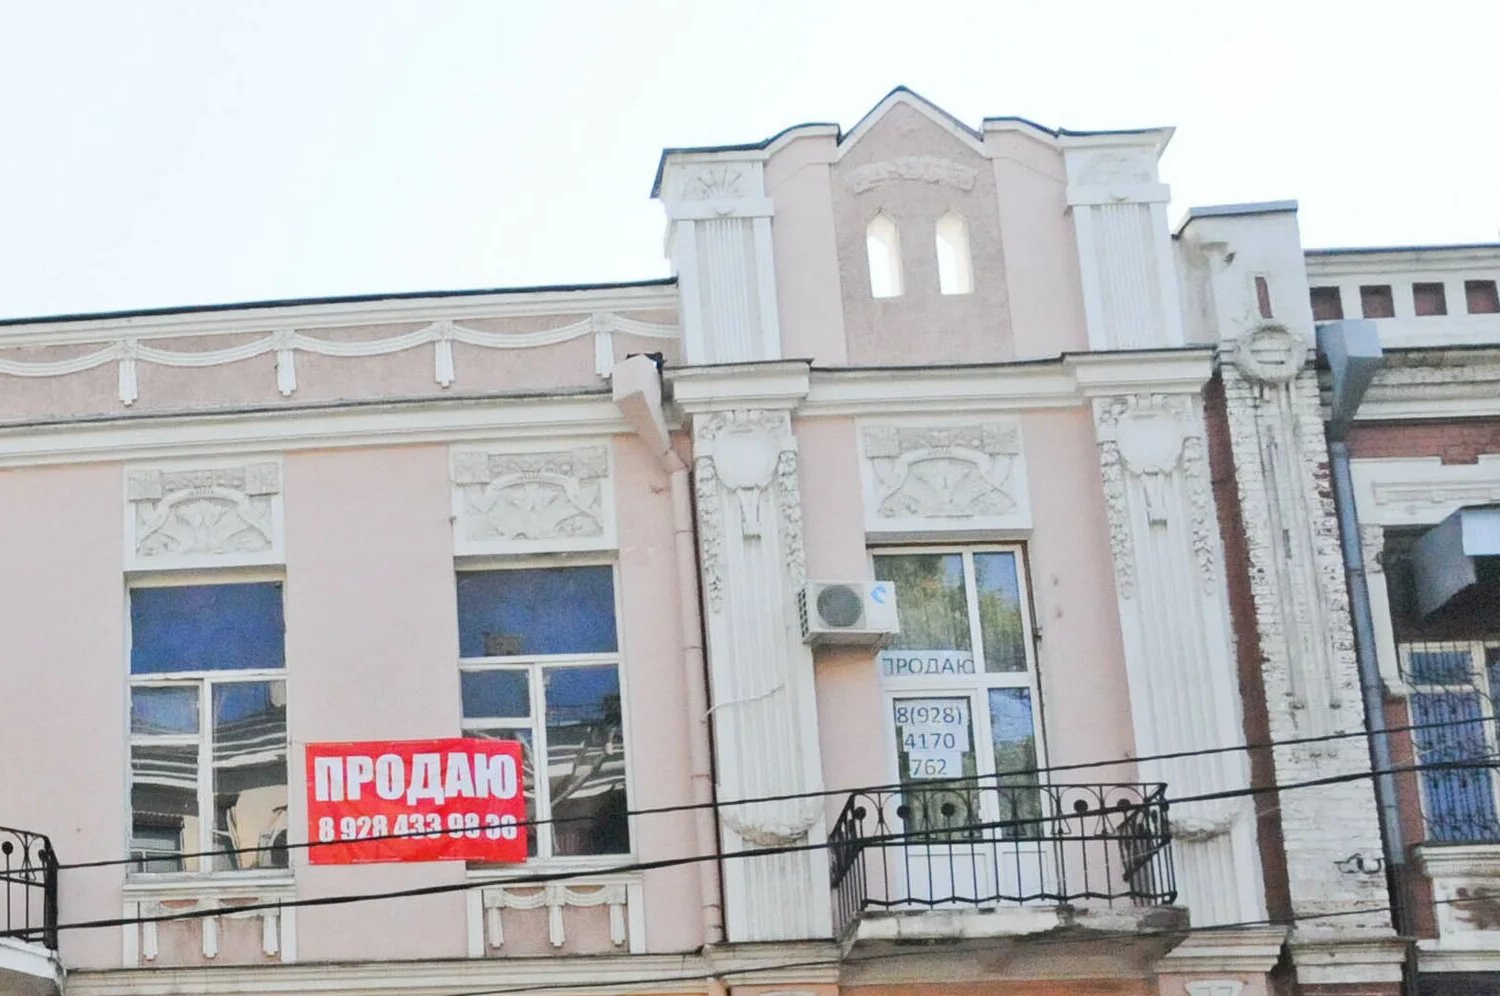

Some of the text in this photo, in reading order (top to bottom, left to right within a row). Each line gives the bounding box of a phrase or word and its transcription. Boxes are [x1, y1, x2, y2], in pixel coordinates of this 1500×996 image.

[882, 658, 975, 674] ПРОДАЮ
[897, 706, 961, 724] 8(928)
[904, 733, 955, 749] 4170
[911, 759, 948, 775] 762
[314, 752, 517, 805] ПРОДАЮ
[318, 816, 335, 842] 8
[340, 815, 388, 839] 928
[393, 813, 441, 839] 433
[448, 813, 480, 838] 98
